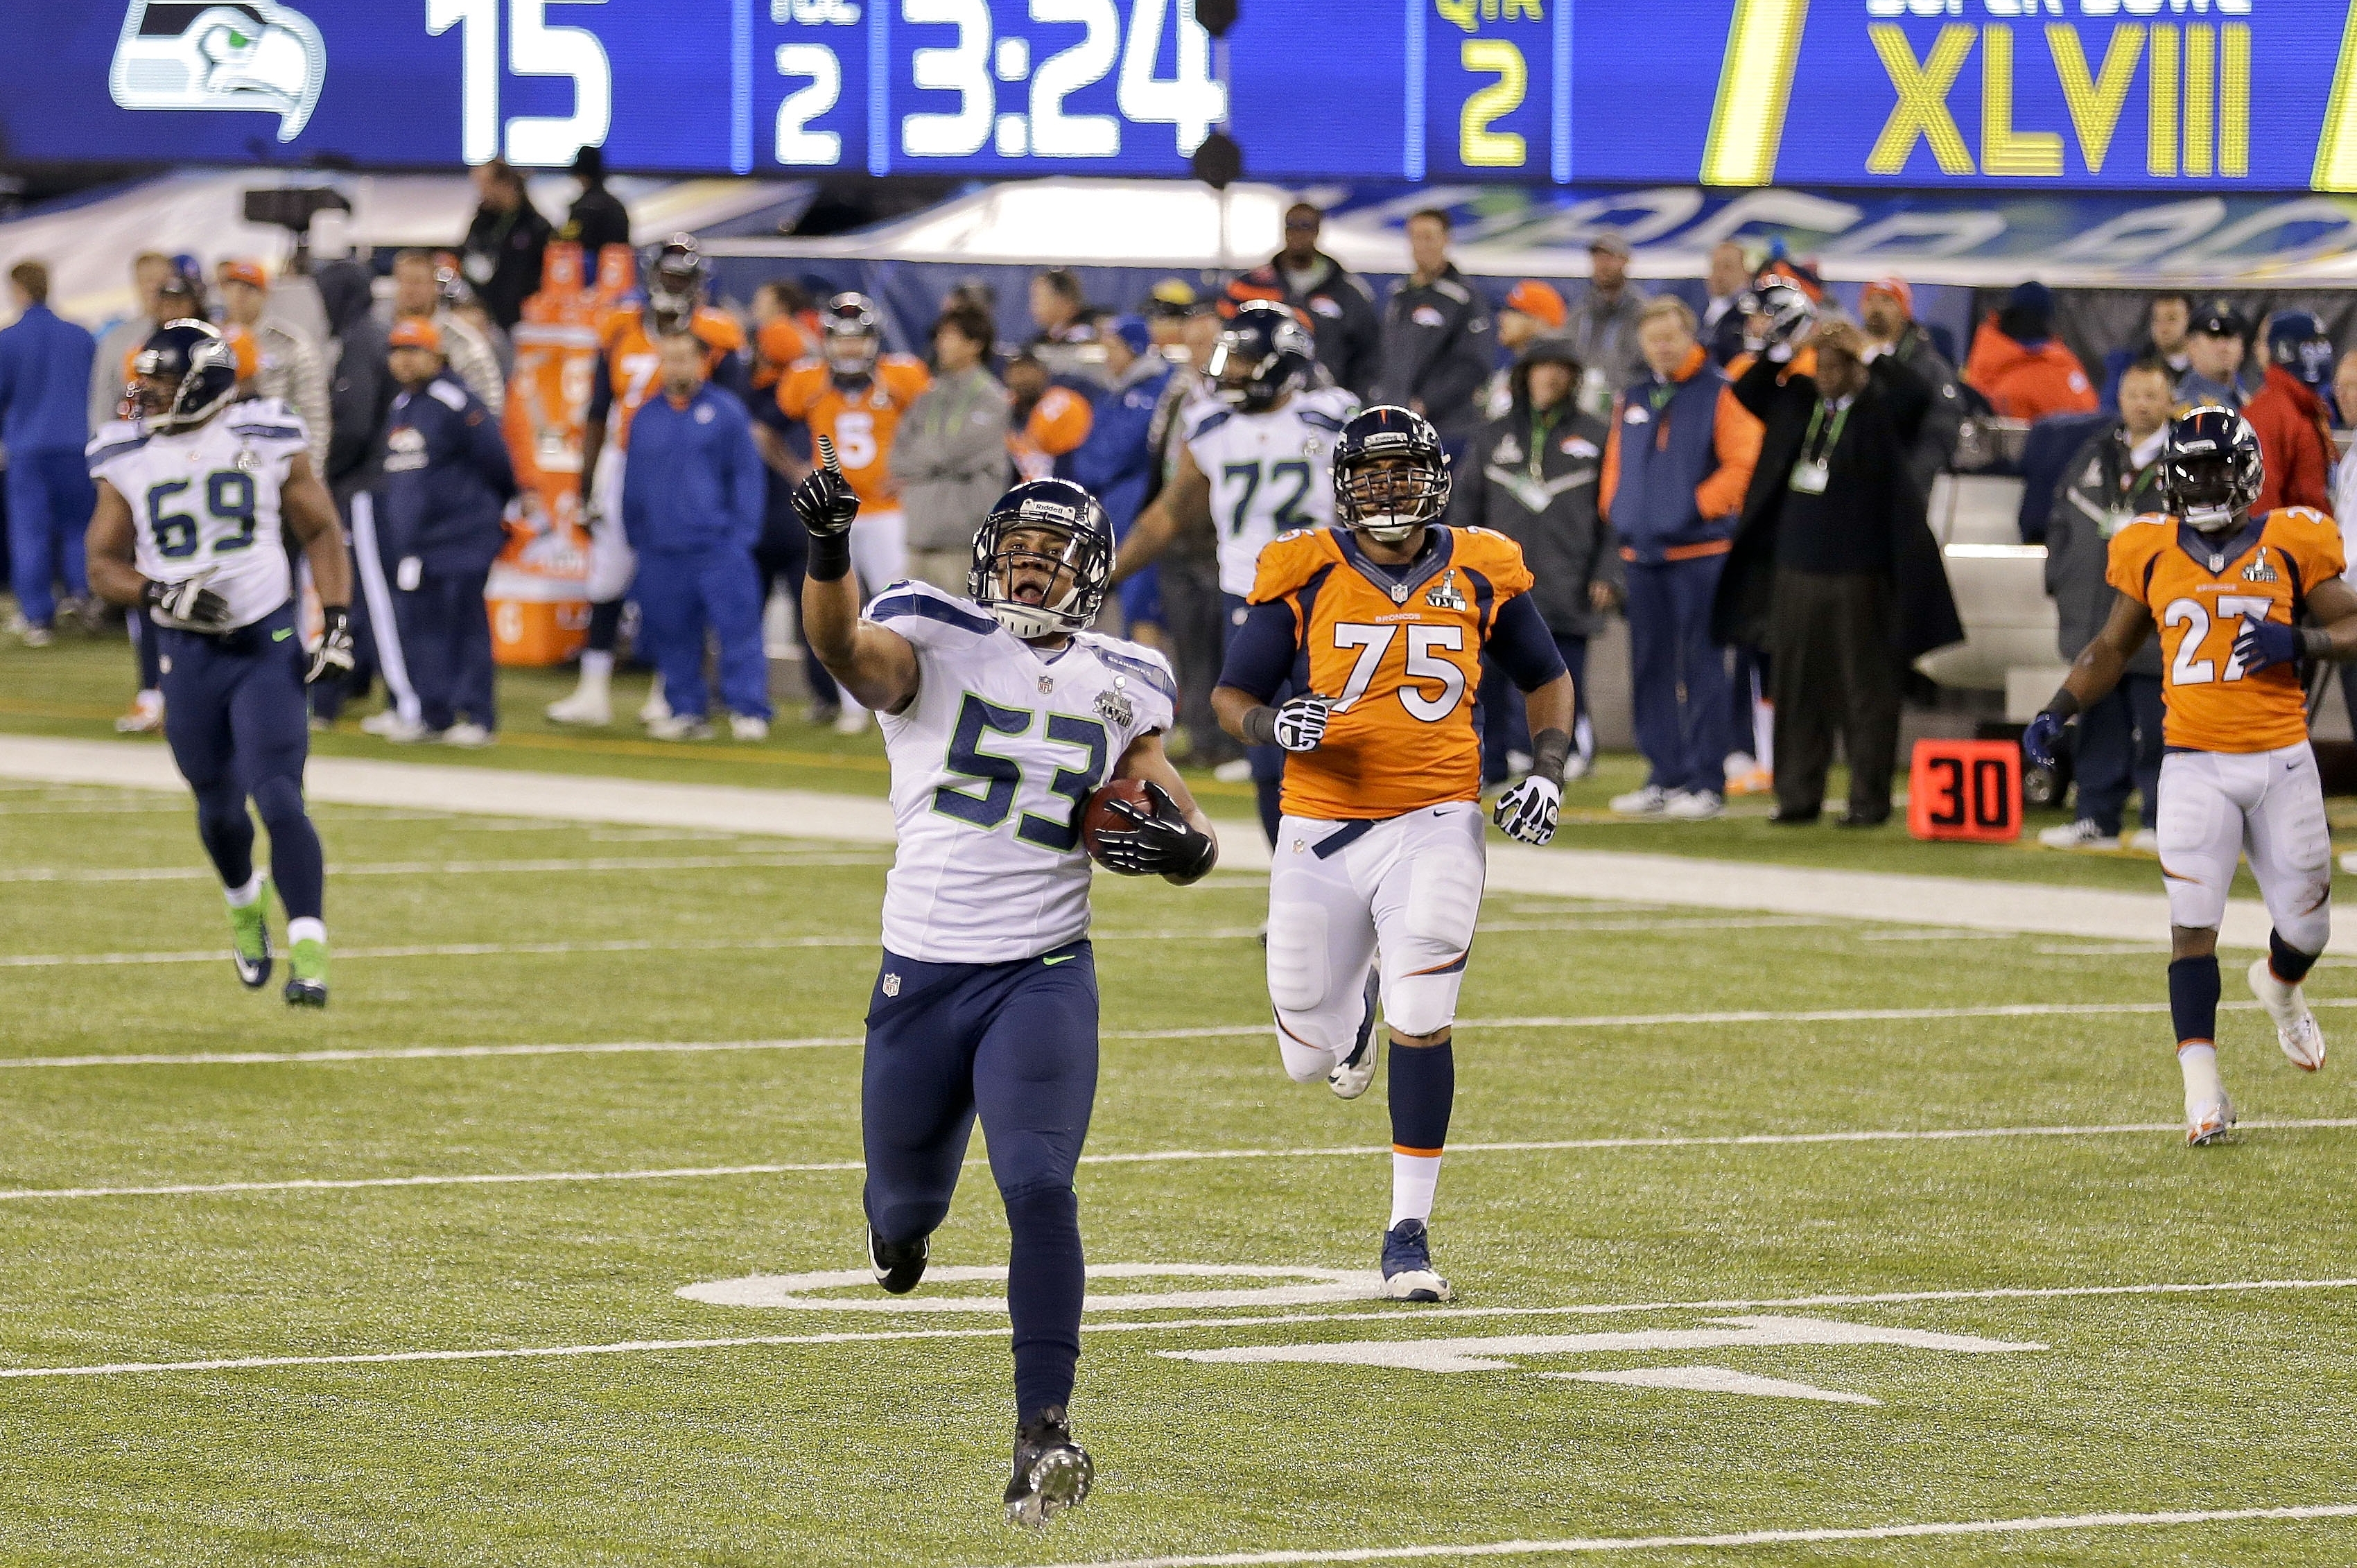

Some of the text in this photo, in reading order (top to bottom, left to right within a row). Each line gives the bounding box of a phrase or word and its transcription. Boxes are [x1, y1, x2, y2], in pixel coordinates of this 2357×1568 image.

[426, 0, 612, 166] 15
[774, 42, 842, 165] 2
[901, 0, 1227, 158] 3:24
[1459, 38, 1528, 166] 2
[1865, 22, 2251, 177] XLVIII
[834, 410, 878, 469] 5
[146, 470, 257, 560] 69
[1035, 504, 1063, 514] Riddell
[1223, 458, 1319, 539] 72
[1038, 683, 1052, 693] NFL
[1330, 622, 1466, 723] 75
[2164, 595, 2274, 686] 27
[929, 690, 1108, 855] 53
[1929, 758, 2009, 827] 30
